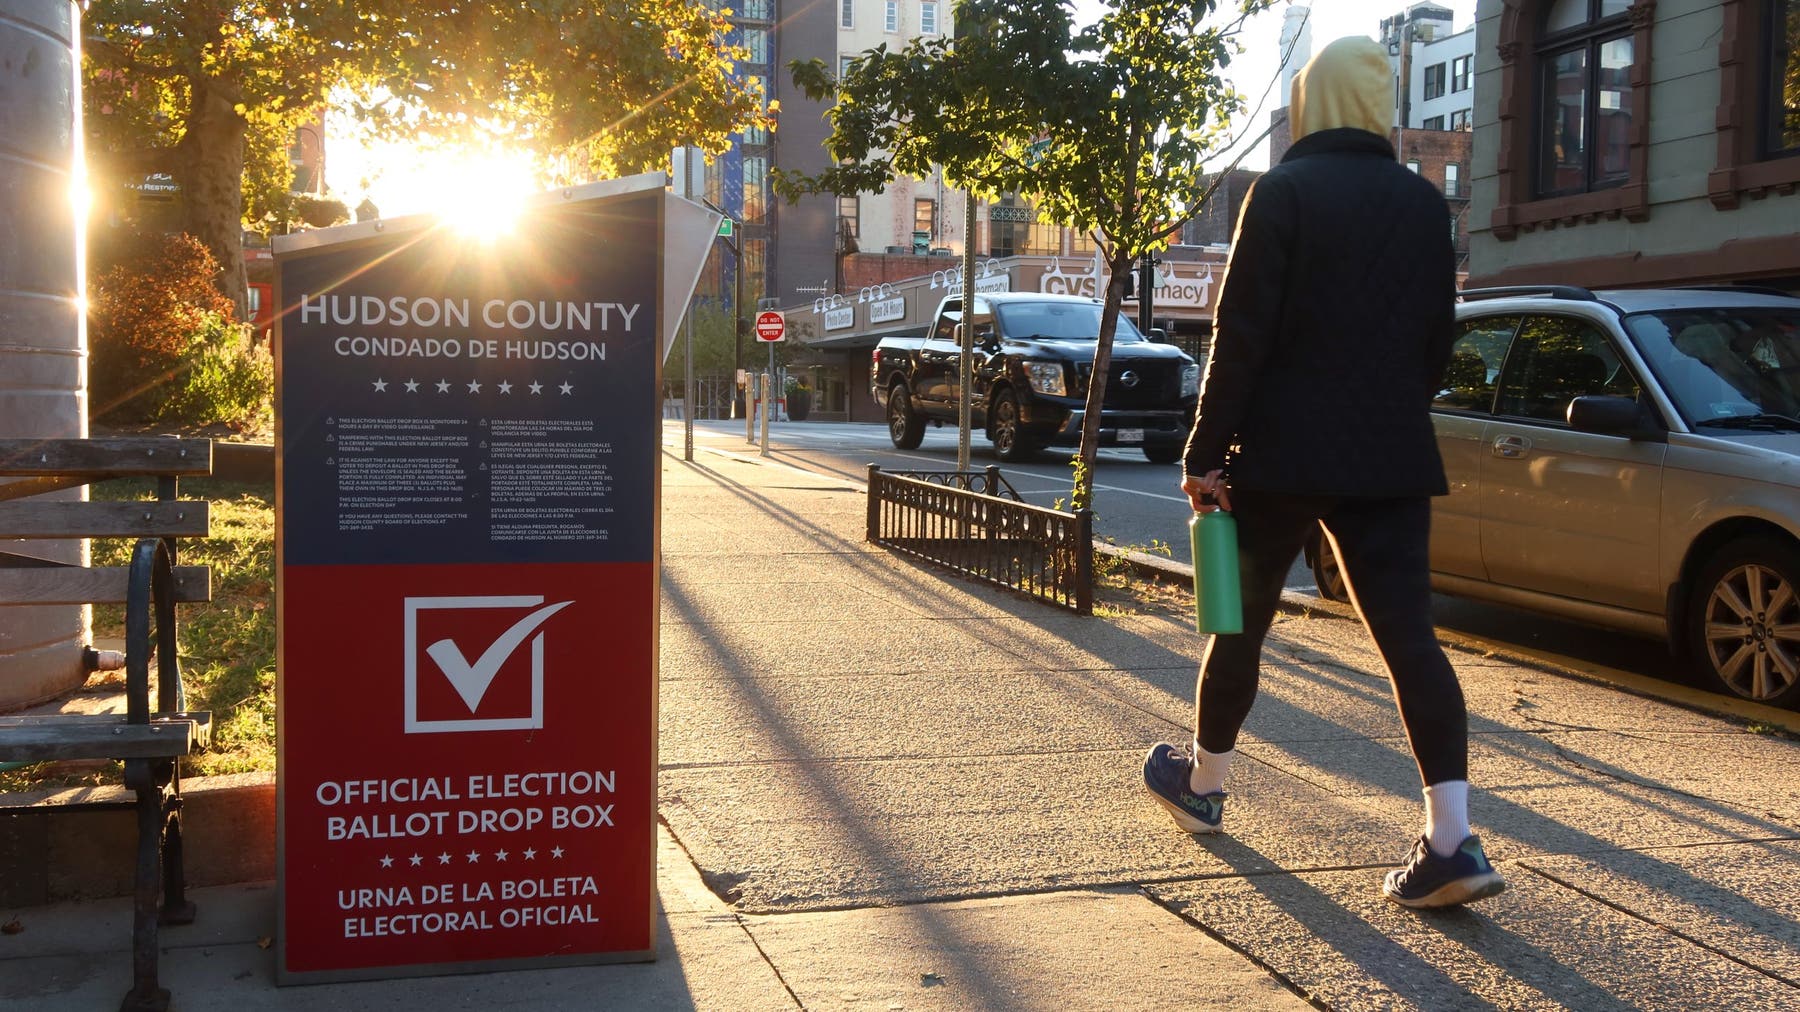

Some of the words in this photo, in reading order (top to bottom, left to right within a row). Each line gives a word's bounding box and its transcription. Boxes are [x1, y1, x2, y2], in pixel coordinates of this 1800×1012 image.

[976, 281, 1008, 292] harmacy
[1046, 276, 1096, 298] CVS
[301, 294, 470, 328] HUDSON
[482, 298, 641, 332] COUNTY
[872, 304, 882, 320] Open
[883, 302, 889, 316] 24
[890, 300, 903, 315] Hours
[334, 336, 461, 358] CONDADO
[468, 339, 498, 359] DE
[505, 340, 607, 361] HUDSON
[316, 777, 460, 806] OFFICIAL
[468, 770, 616, 799] ELECTION
[1180, 792, 1208, 814] HOKA
[327, 811, 450, 841] BALLOT
[458, 807, 544, 834] DROP
[552, 804, 615, 829] BOX
[338, 886, 415, 910] URNA
[421, 883, 454, 905] DE
[462, 881, 495, 902] LA
[501, 876, 599, 900] BOLETA
[344, 910, 493, 938] ELECTORAL
[499, 903, 599, 928] OFICIAL
